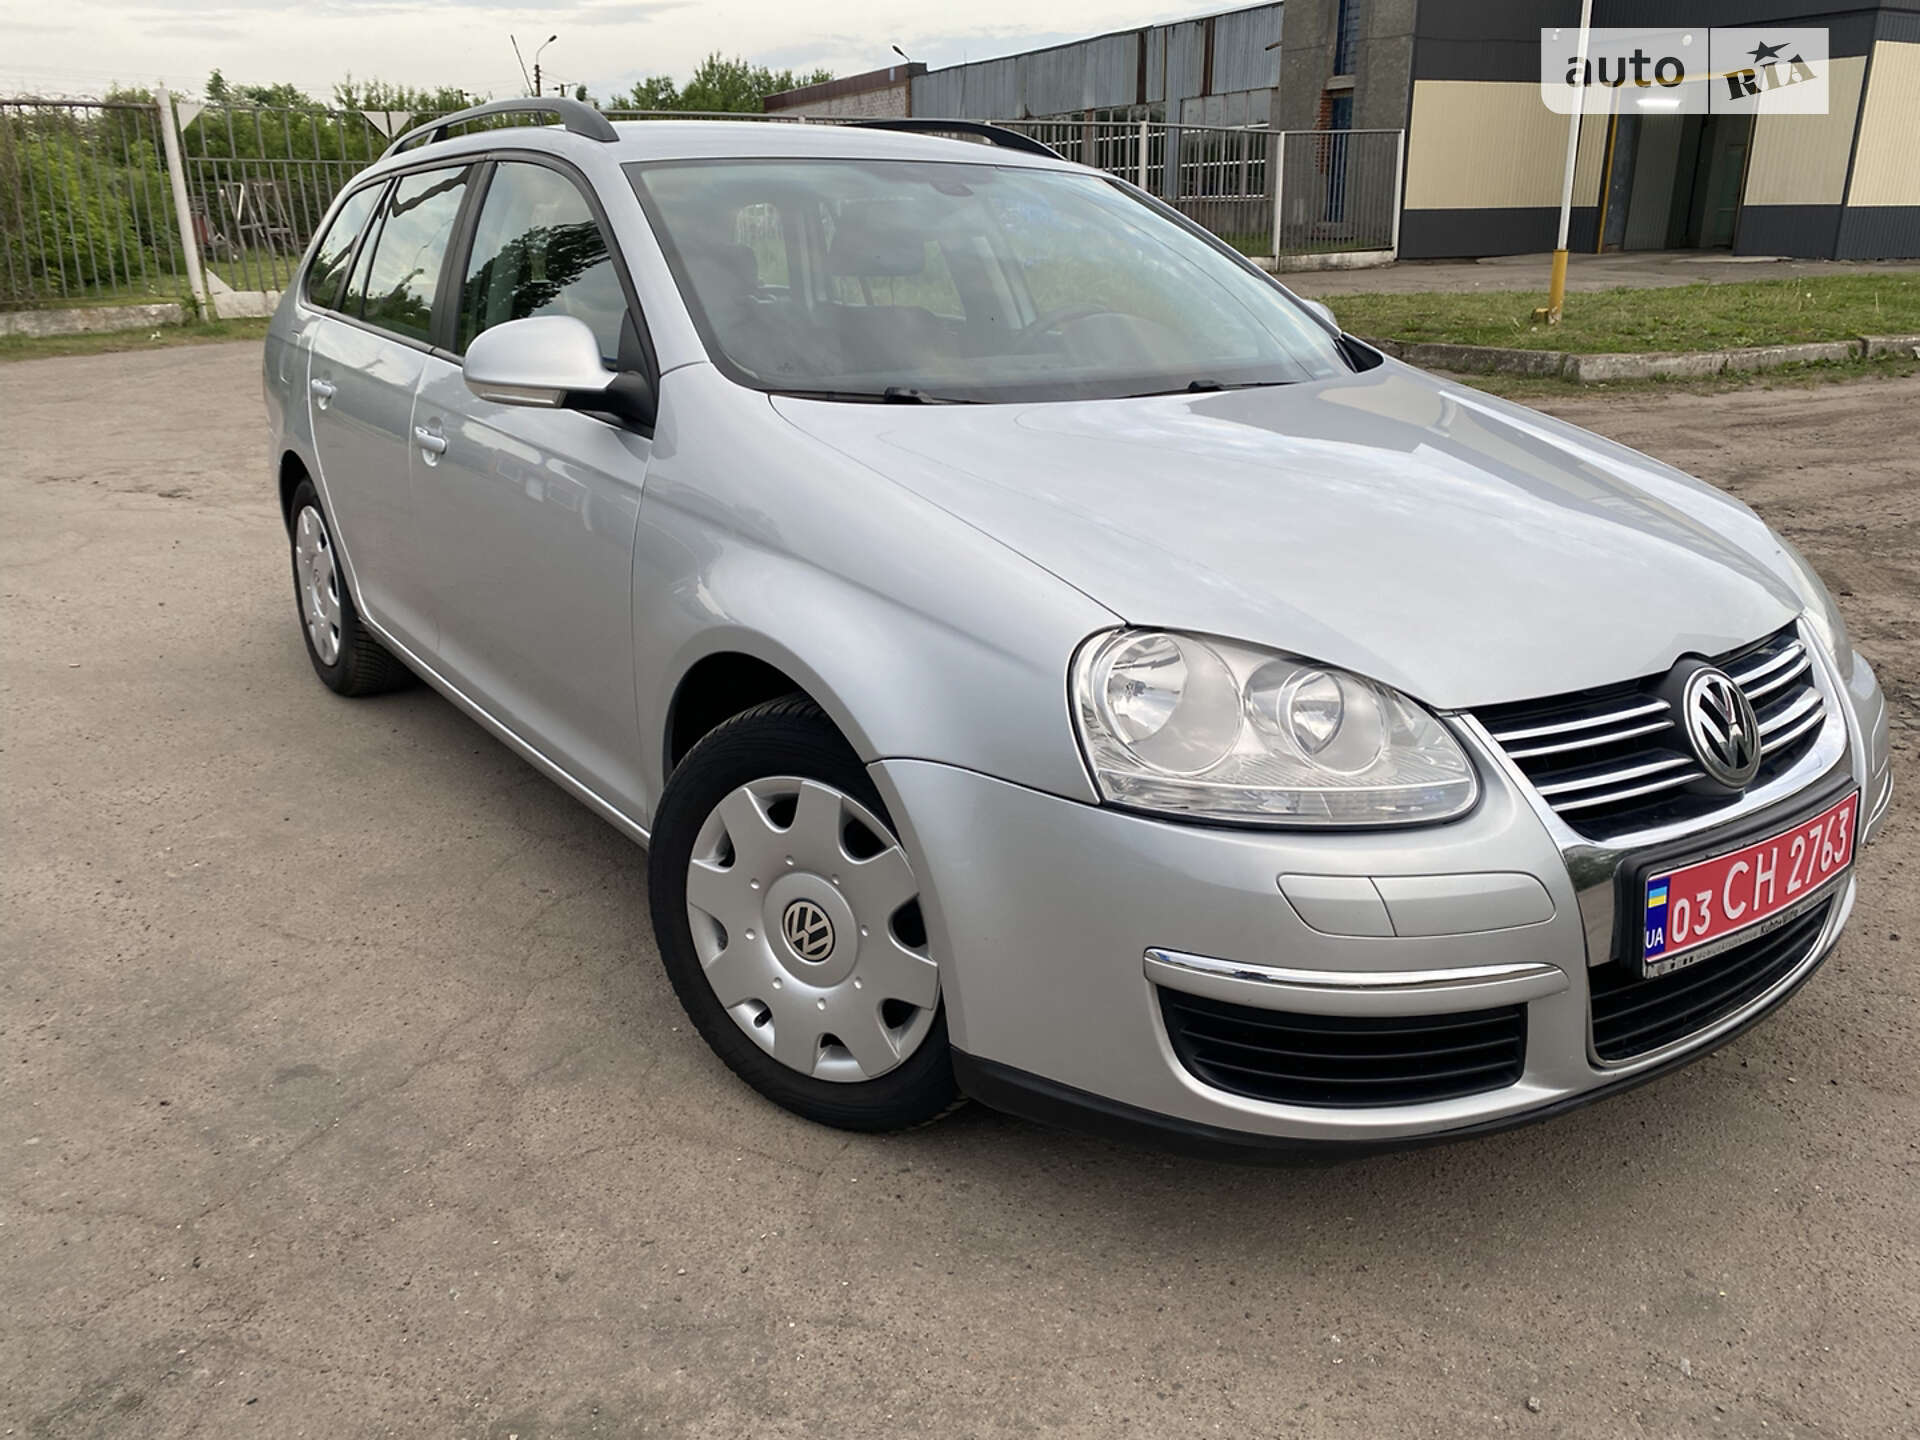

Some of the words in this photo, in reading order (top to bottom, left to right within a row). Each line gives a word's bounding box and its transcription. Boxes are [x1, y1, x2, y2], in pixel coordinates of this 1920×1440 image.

[1671, 889, 1713, 944] 03
[1723, 847, 1778, 920] CH
[1787, 807, 1850, 895] 2763
[1645, 927, 1664, 949] UA
